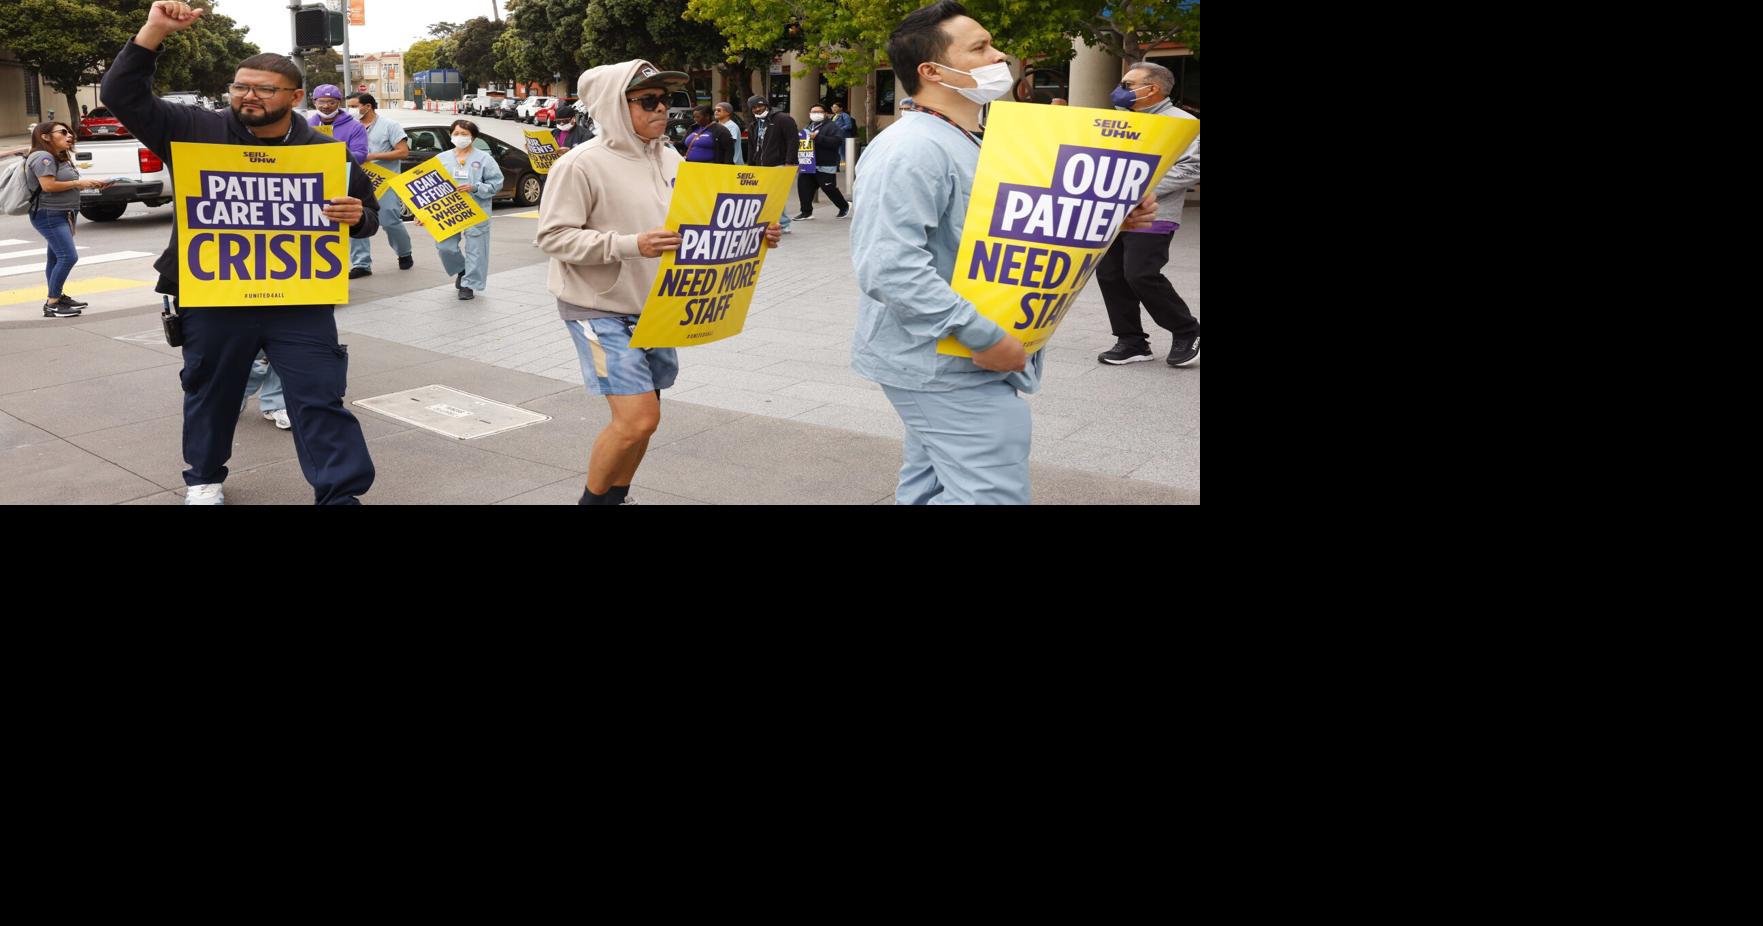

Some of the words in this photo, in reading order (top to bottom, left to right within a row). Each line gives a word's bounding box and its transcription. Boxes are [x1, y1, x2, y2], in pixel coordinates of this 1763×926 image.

[1093, 118, 1132, 129] SEIU-
[1101, 128, 1142, 140] UHW
[208, 175, 317, 202] PATIENT
[407, 183, 418, 195] I
[413, 170, 443, 192] CAN'T
[1062, 153, 1150, 201] OUR
[416, 181, 454, 207] AFFORD
[424, 202, 441, 214] TO
[440, 192, 463, 207] LIVE
[196, 201, 265, 226] CARE
[272, 203, 296, 226] IS
[303, 203, 330, 227] IN
[432, 200, 469, 221] WHERE
[438, 222, 446, 230] I
[443, 208, 476, 227] WORK
[716, 198, 761, 229] OUR
[187, 232, 342, 281] CRISIS
[680, 226, 765, 260] PATIENTS
[968, 240, 1071, 289] NEED
[657, 268, 717, 297] NEED
[717, 260, 760, 294] MORE
[680, 294, 733, 326] STAFF
[1013, 291, 1077, 330] STA
